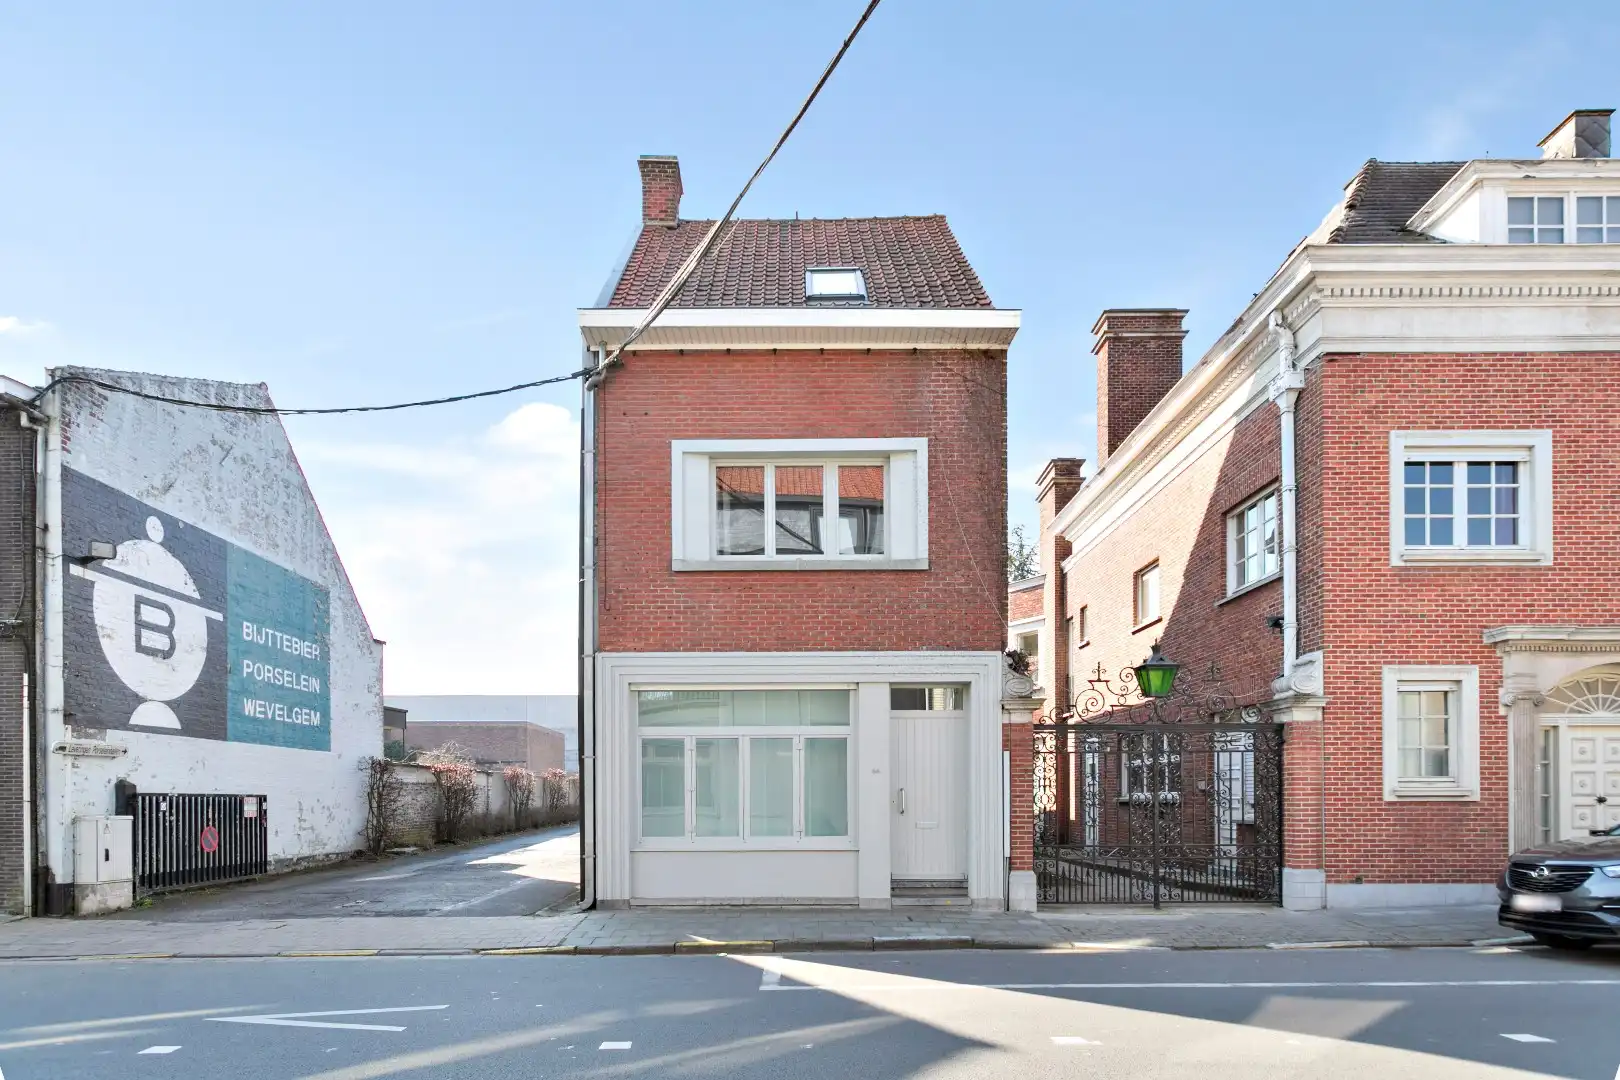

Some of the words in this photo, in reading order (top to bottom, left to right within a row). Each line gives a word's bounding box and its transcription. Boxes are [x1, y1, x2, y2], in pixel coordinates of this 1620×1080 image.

[134, 594, 176, 660] B
[242, 620, 320, 661] BIJTTEBIER
[243, 659, 320, 694] PORSELEIN
[243, 697, 320, 727] WEVELGEM
